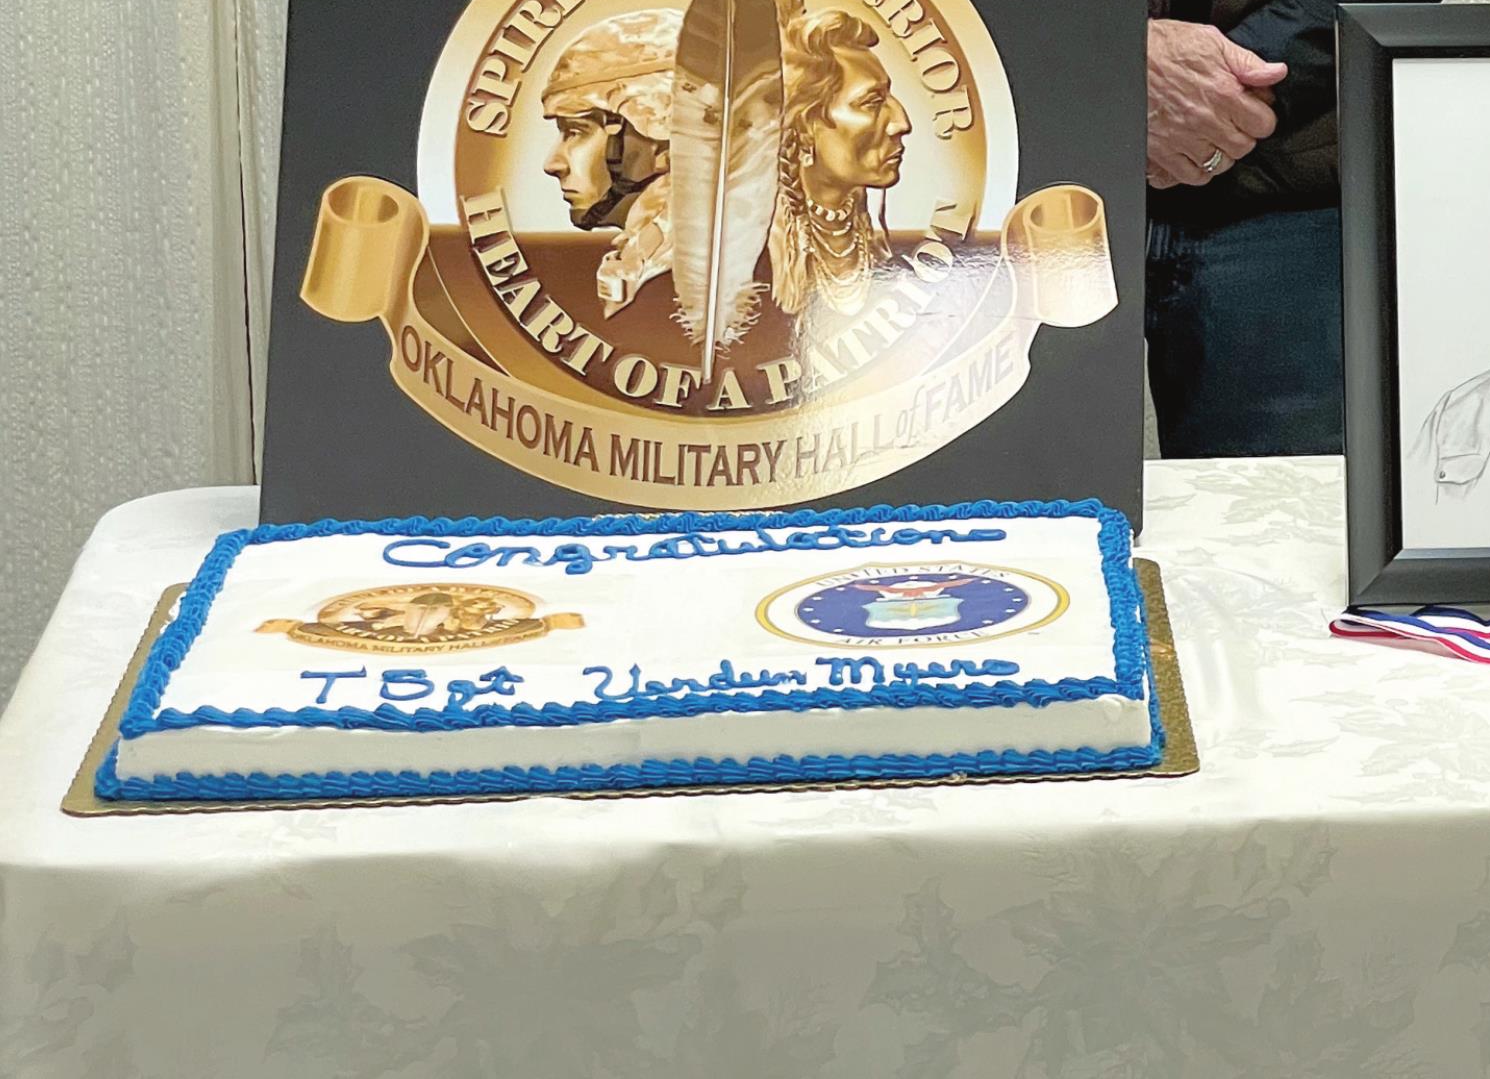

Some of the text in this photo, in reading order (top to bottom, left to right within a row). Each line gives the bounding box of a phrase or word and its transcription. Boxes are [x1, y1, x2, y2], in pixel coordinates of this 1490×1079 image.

[461, 188, 974, 411] HEART OF A PATRIOT
[401, 325, 1019, 488] OKLAHOMA MILITARY HALL of FAME
[382, 526, 1007, 575] Congratulations
[371, 643, 445, 654] MILITARY
